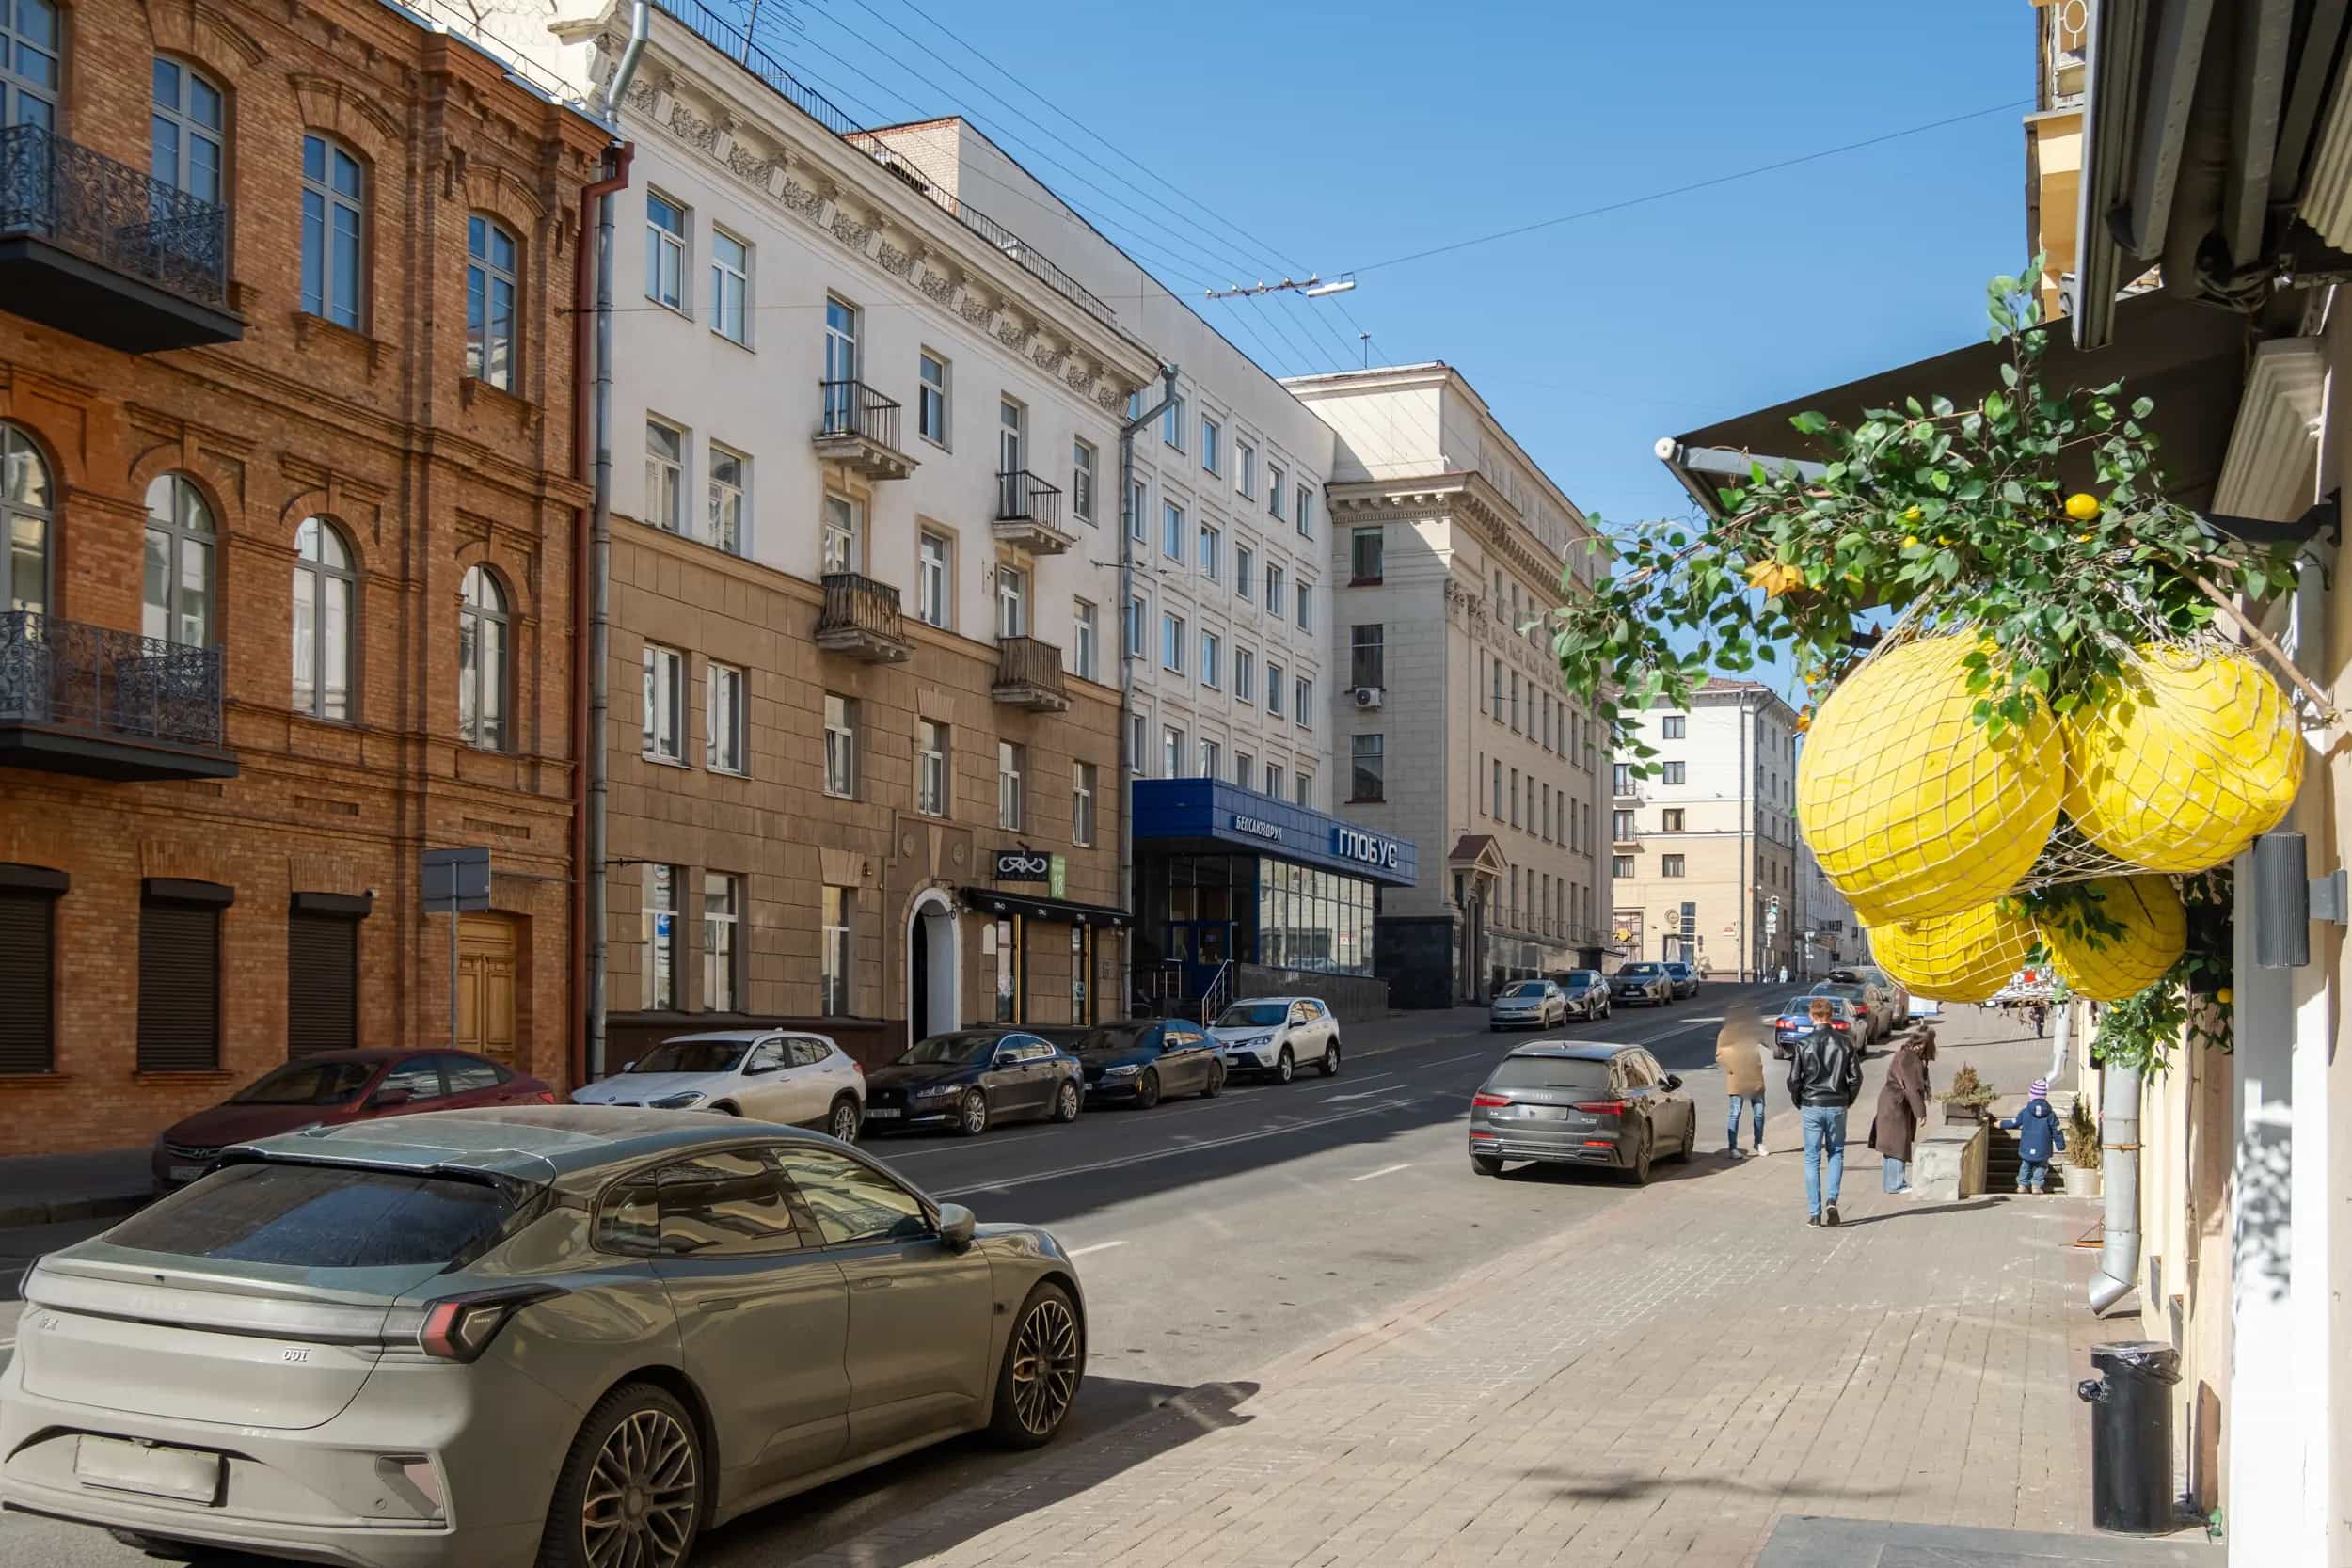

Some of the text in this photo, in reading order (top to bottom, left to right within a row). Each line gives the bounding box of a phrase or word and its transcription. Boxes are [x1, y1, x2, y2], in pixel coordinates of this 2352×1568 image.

[1236, 816, 1283, 841] БЕЛСАЮЗДРУК
[1339, 828, 1398, 868] ГЛОБУС
[1053, 872, 1063, 896] 18
